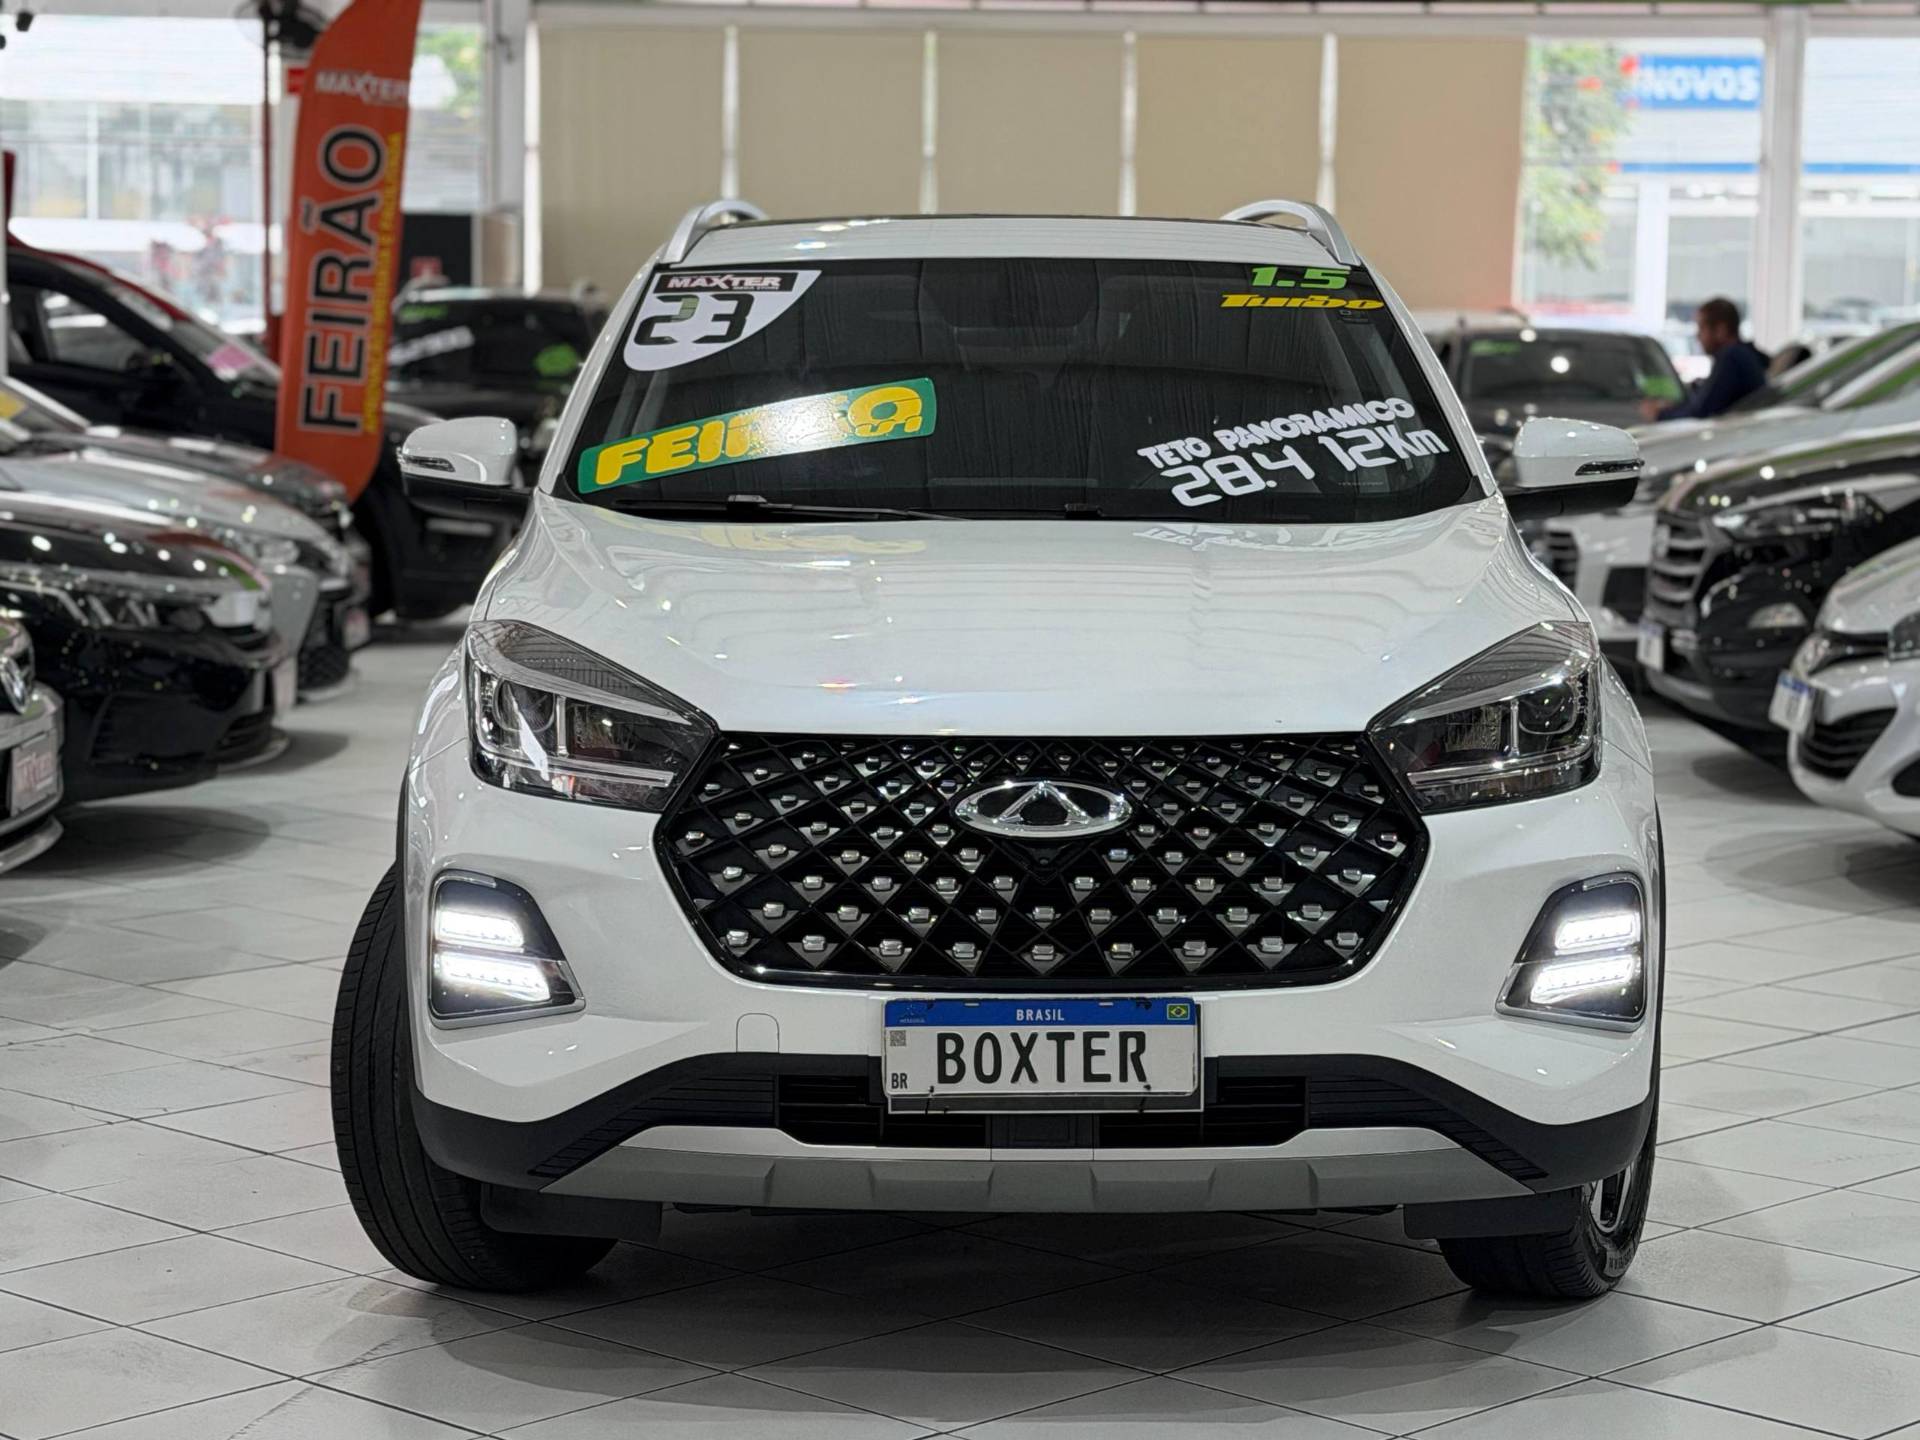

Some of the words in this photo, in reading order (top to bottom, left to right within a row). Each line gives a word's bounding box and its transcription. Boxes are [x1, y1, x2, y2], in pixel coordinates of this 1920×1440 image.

[297, 126, 388, 434] FEIRÃO
[667, 274, 782, 290] MAXTER
[1251, 266, 1351, 290] 1.5
[633, 293, 755, 346] 23
[1221, 294, 1385, 310] Turbo
[595, 386, 923, 485] FEIO
[1137, 436, 1212, 469] TETO
[1217, 398, 1416, 453] PANORAMICO
[1016, 1009, 1065, 1022] BRASIL
[937, 1031, 1148, 1084] BOXTER
[891, 1073, 908, 1090] BR
